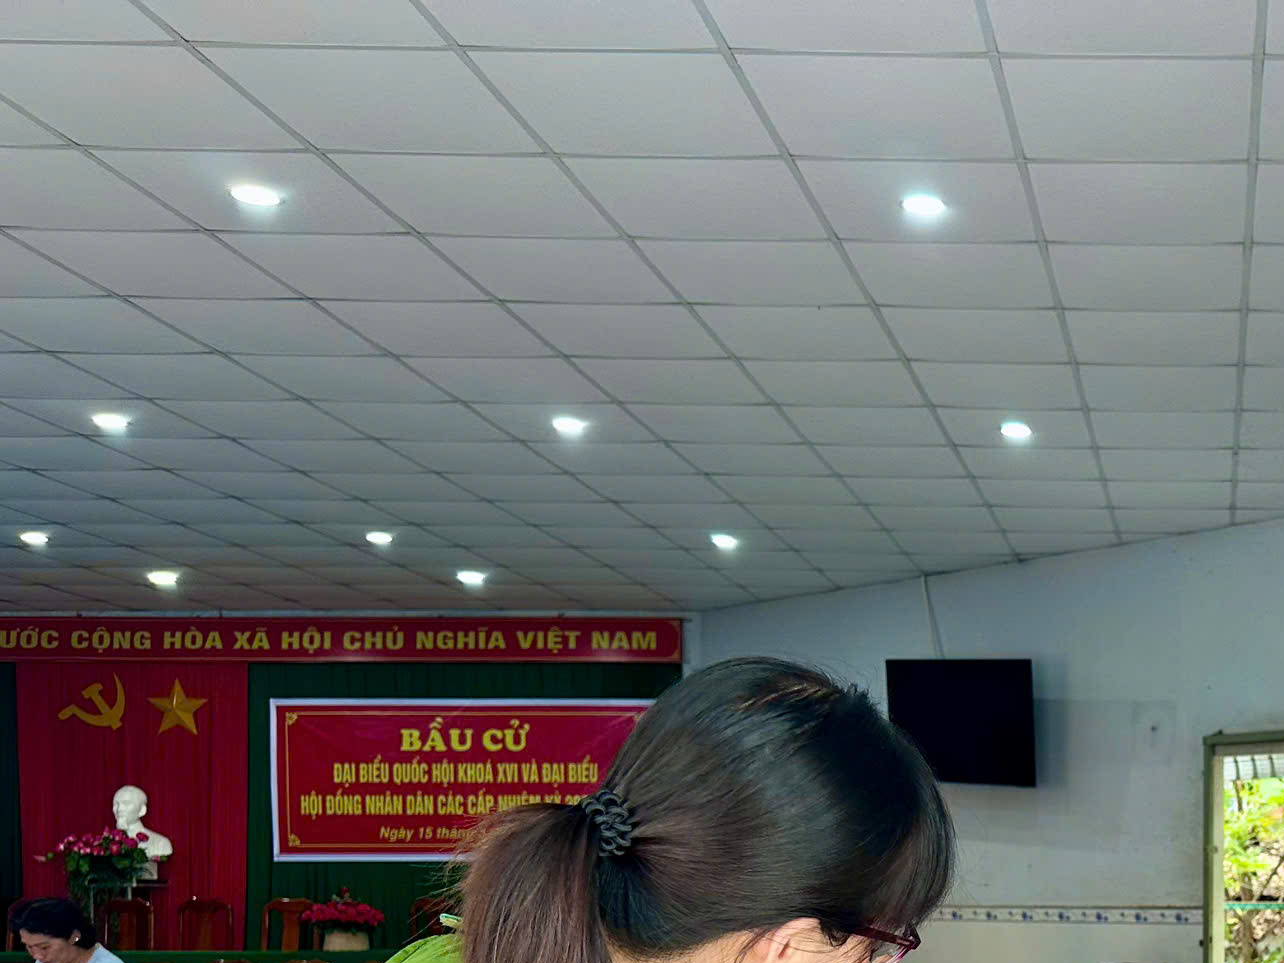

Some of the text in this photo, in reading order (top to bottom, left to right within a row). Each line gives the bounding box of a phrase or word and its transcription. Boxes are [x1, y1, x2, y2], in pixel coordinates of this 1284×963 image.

[71, 625, 152, 653] CỘNG
[163, 626, 224, 649] HÒA
[232, 626, 271, 650] XÃ
[281, 625, 332, 654] HỘI
[343, 624, 404, 650] CHỦ
[416, 626, 506, 650] NGHĨA
[516, 625, 581, 653] VIỆT
[591, 630, 657, 650] NAM
[400, 716, 530, 752] BẦU CỬ
[333, 754, 598, 788] ĐẠI BIỂU QUỐC HỘI KHOÁ XVI VÀ ĐẠI BIỂU
[300, 790, 323, 820] HỘI
[365, 790, 403, 816] NHÂN
[406, 790, 434, 816] DÂN
[437, 790, 464, 816] CÁC
[467, 787, 495, 816] CẤP
[379, 826, 414, 842] Ngày
[418, 826, 433, 840] 15
